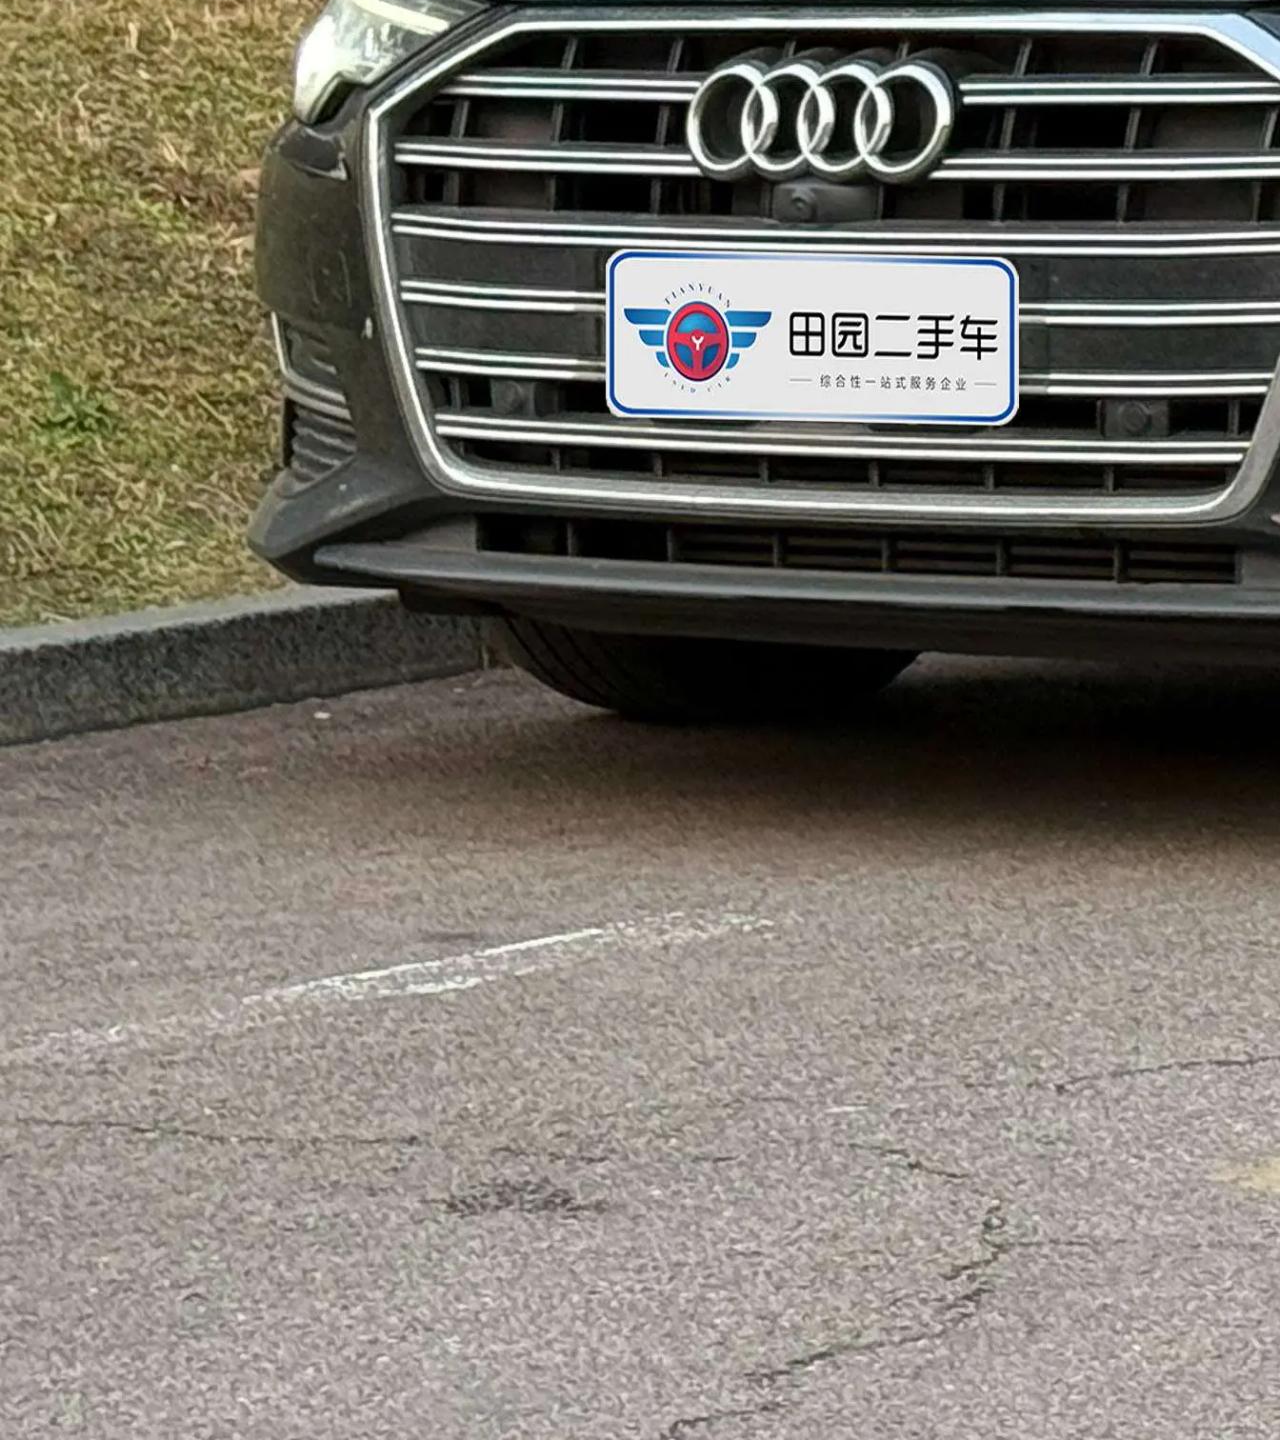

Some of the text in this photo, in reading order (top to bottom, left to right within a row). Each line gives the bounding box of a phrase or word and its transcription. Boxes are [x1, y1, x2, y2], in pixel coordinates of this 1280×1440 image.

[789, 311, 998, 361] 田园二手车
[820, 374, 967, 391] 综合性一站式服务企业
